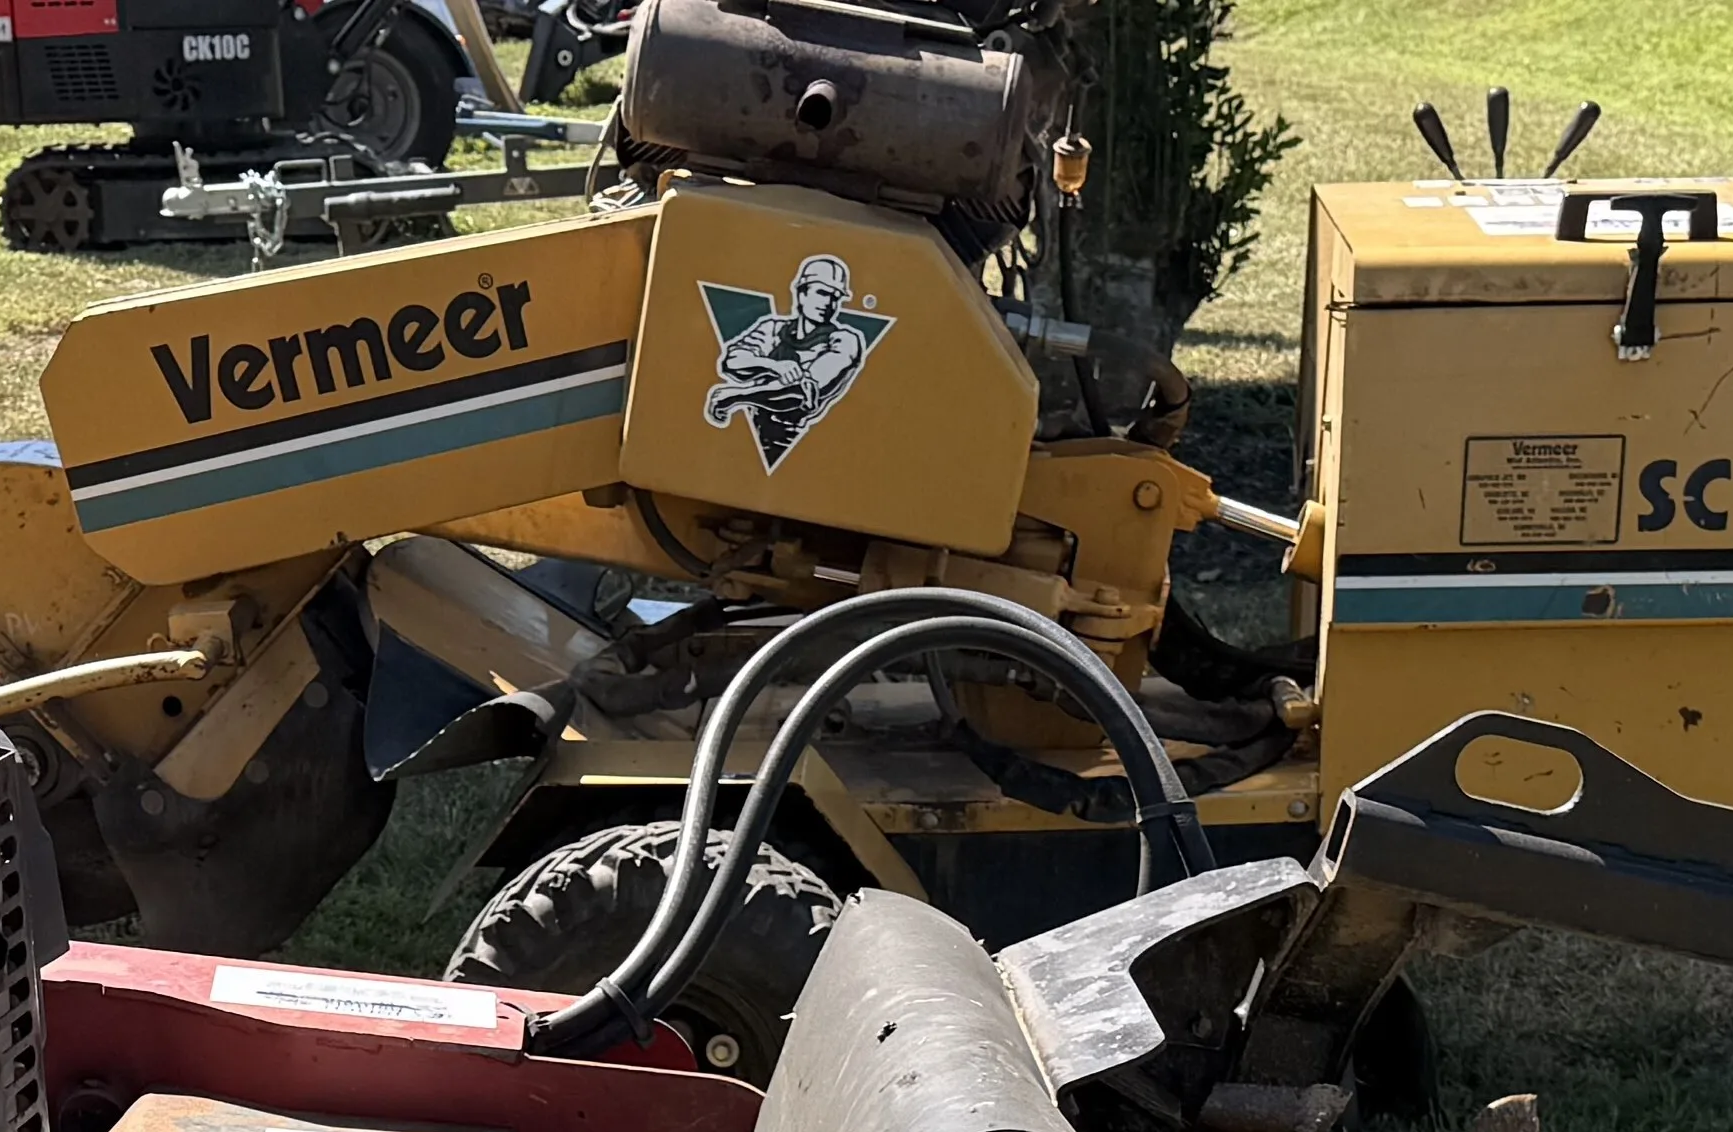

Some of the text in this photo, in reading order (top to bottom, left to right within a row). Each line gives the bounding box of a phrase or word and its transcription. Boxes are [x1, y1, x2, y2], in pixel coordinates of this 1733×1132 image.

[183, 34, 251, 61] CK10C
[150, 279, 533, 425] Vermeer
[1513, 441, 1578, 456] Vermeer
